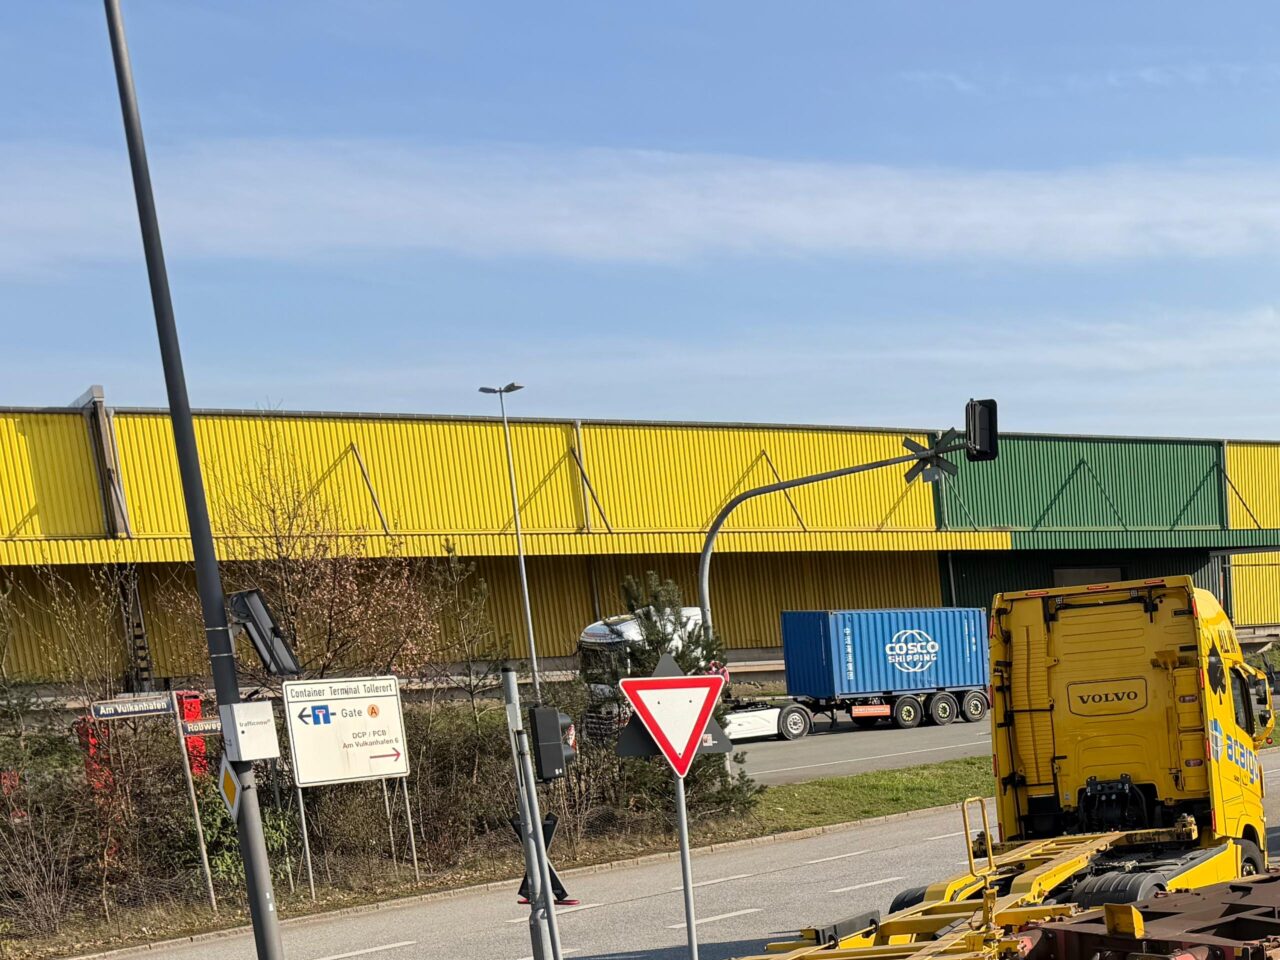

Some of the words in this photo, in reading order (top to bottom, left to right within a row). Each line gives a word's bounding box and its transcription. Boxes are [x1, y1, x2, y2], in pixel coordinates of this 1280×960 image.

[885, 641, 939, 655] COSCO
[888, 654, 937, 664] SHIPPING
[290, 688, 325, 698] Container
[329, 685, 360, 696] Terminal
[363, 683, 393, 694] Tollerort
[1078, 690, 1138, 704] VOLVO
[100, 705, 114, 715] Am
[116, 700, 167, 713] Vulkanhafen
[341, 708, 363, 718] Gate
[352, 731, 367, 739] DCP
[355, 738, 394, 748] Vulkanhafen
